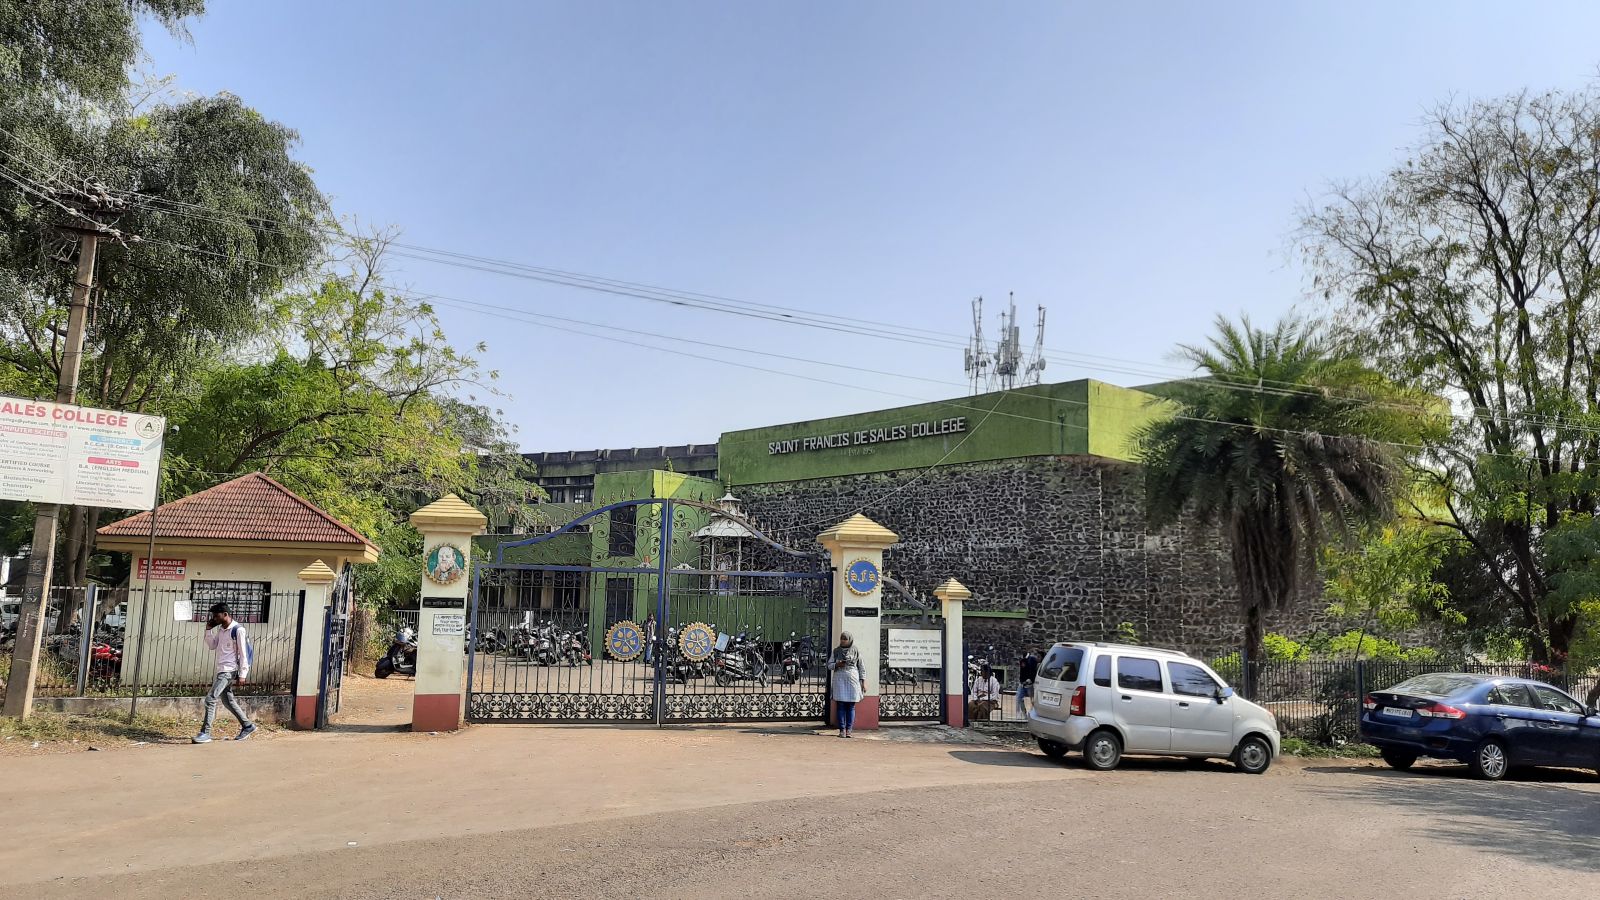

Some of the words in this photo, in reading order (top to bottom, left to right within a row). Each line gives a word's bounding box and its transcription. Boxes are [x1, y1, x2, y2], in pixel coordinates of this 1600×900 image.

[52, 408, 129, 428] COLLEGE
[768, 439, 799, 455] SAINT
[803, 432, 849, 451] FRANCIS
[853, 430, 868, 445] DE
[869, 425, 907, 443] SALES
[911, 416, 966, 438] COLLEGE
